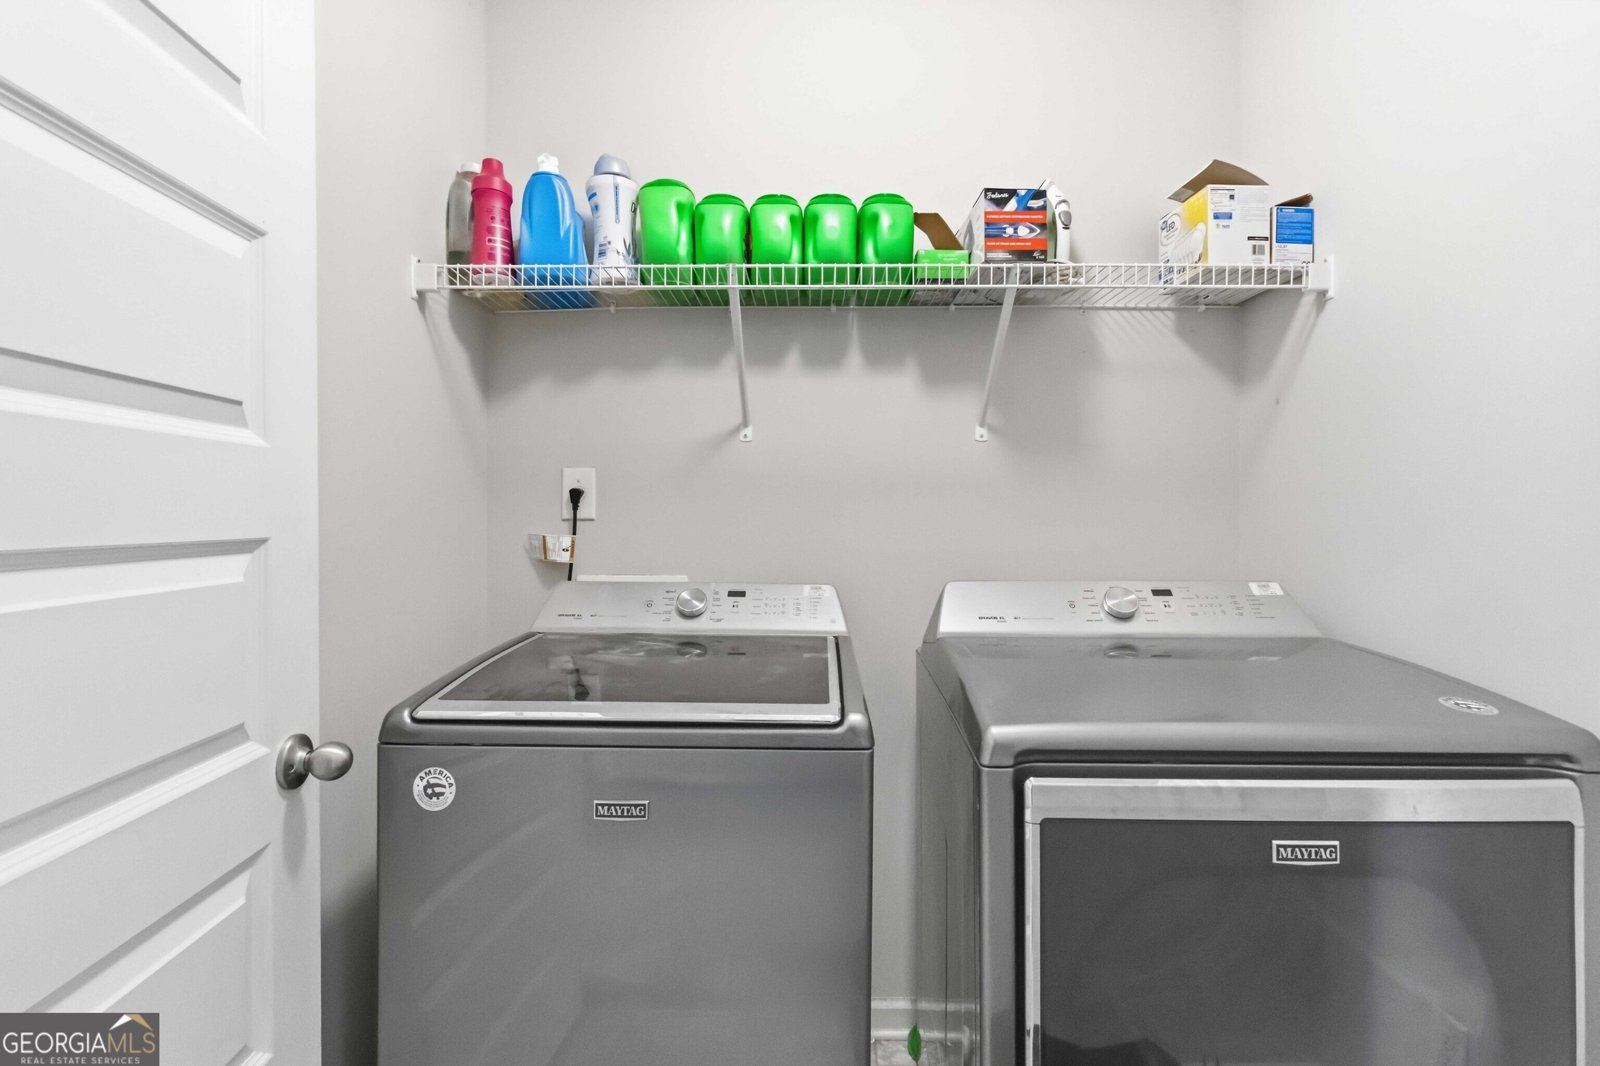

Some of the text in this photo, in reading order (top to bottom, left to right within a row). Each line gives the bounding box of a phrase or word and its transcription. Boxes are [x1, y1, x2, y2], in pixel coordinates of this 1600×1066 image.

[419, 768, 454, 789] AMERICA
[597, 805, 645, 816] MAYTAG
[1278, 847, 1336, 859] MAYTAG
